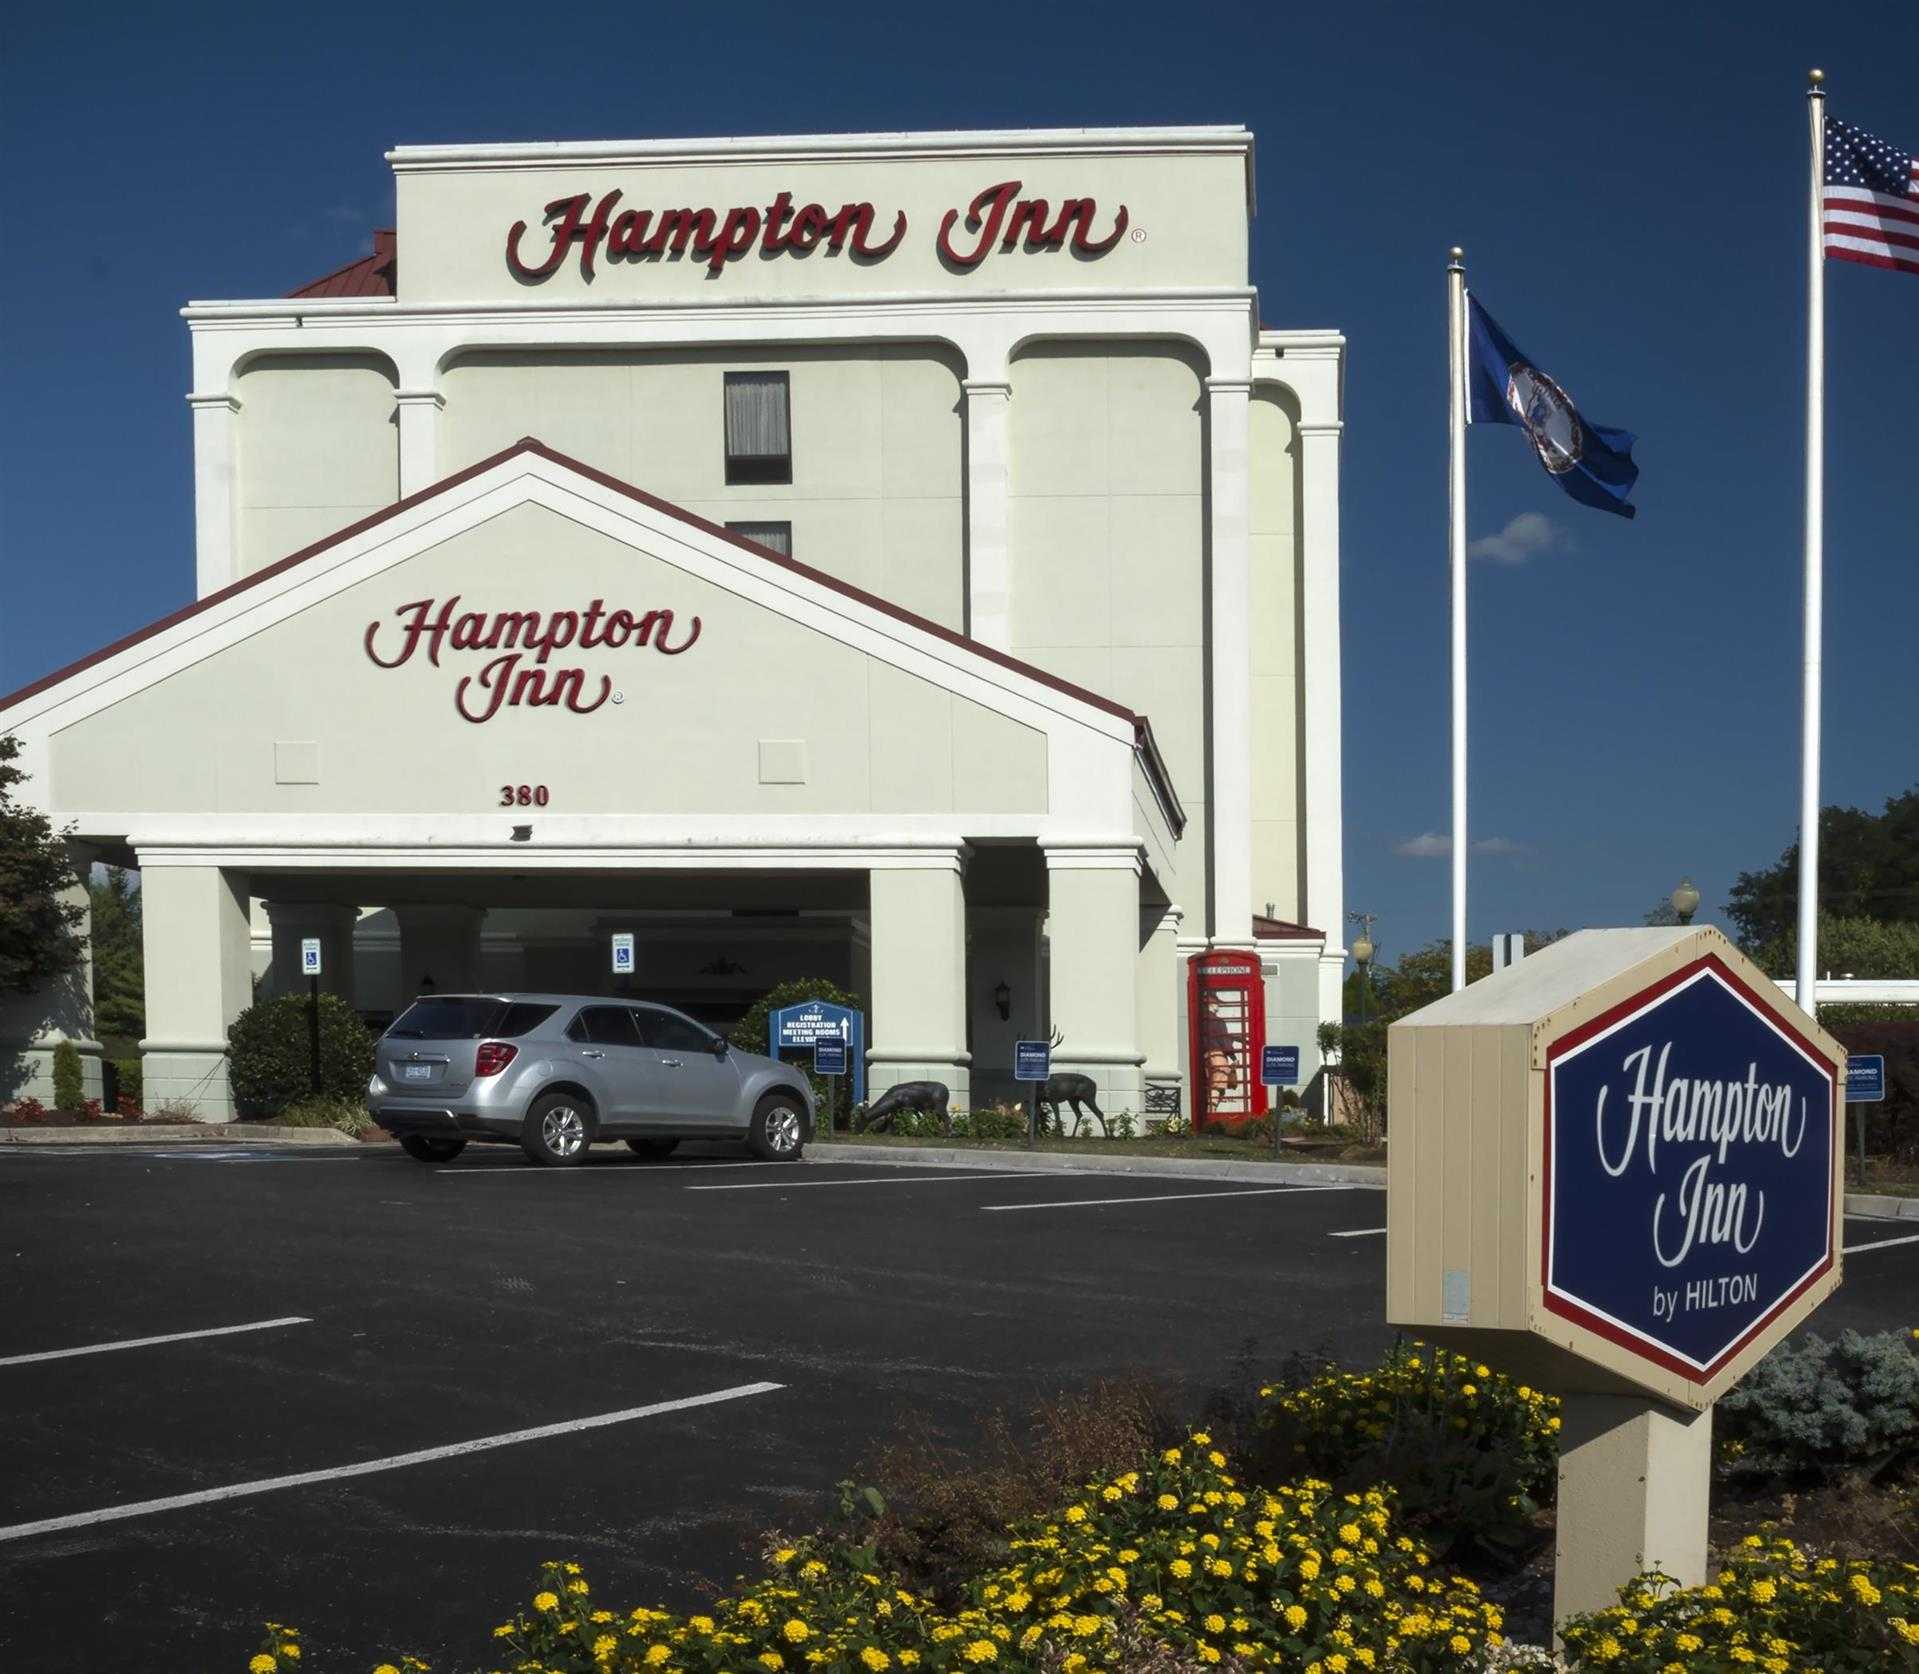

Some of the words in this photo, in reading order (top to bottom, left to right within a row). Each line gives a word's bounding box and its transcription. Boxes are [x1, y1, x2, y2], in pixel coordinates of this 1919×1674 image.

[507, 189, 907, 284] Hampton
[936, 181, 1129, 273] Inn
[365, 596, 702, 668] Hampton
[456, 653, 612, 723] Inn
[500, 785, 549, 806] 380
[1597, 1041, 1806, 1177] Hampton
[1653, 1154, 1764, 1268] Inn
[1653, 1285, 1679, 1323] by
[1685, 1273, 1758, 1312] HILTON
